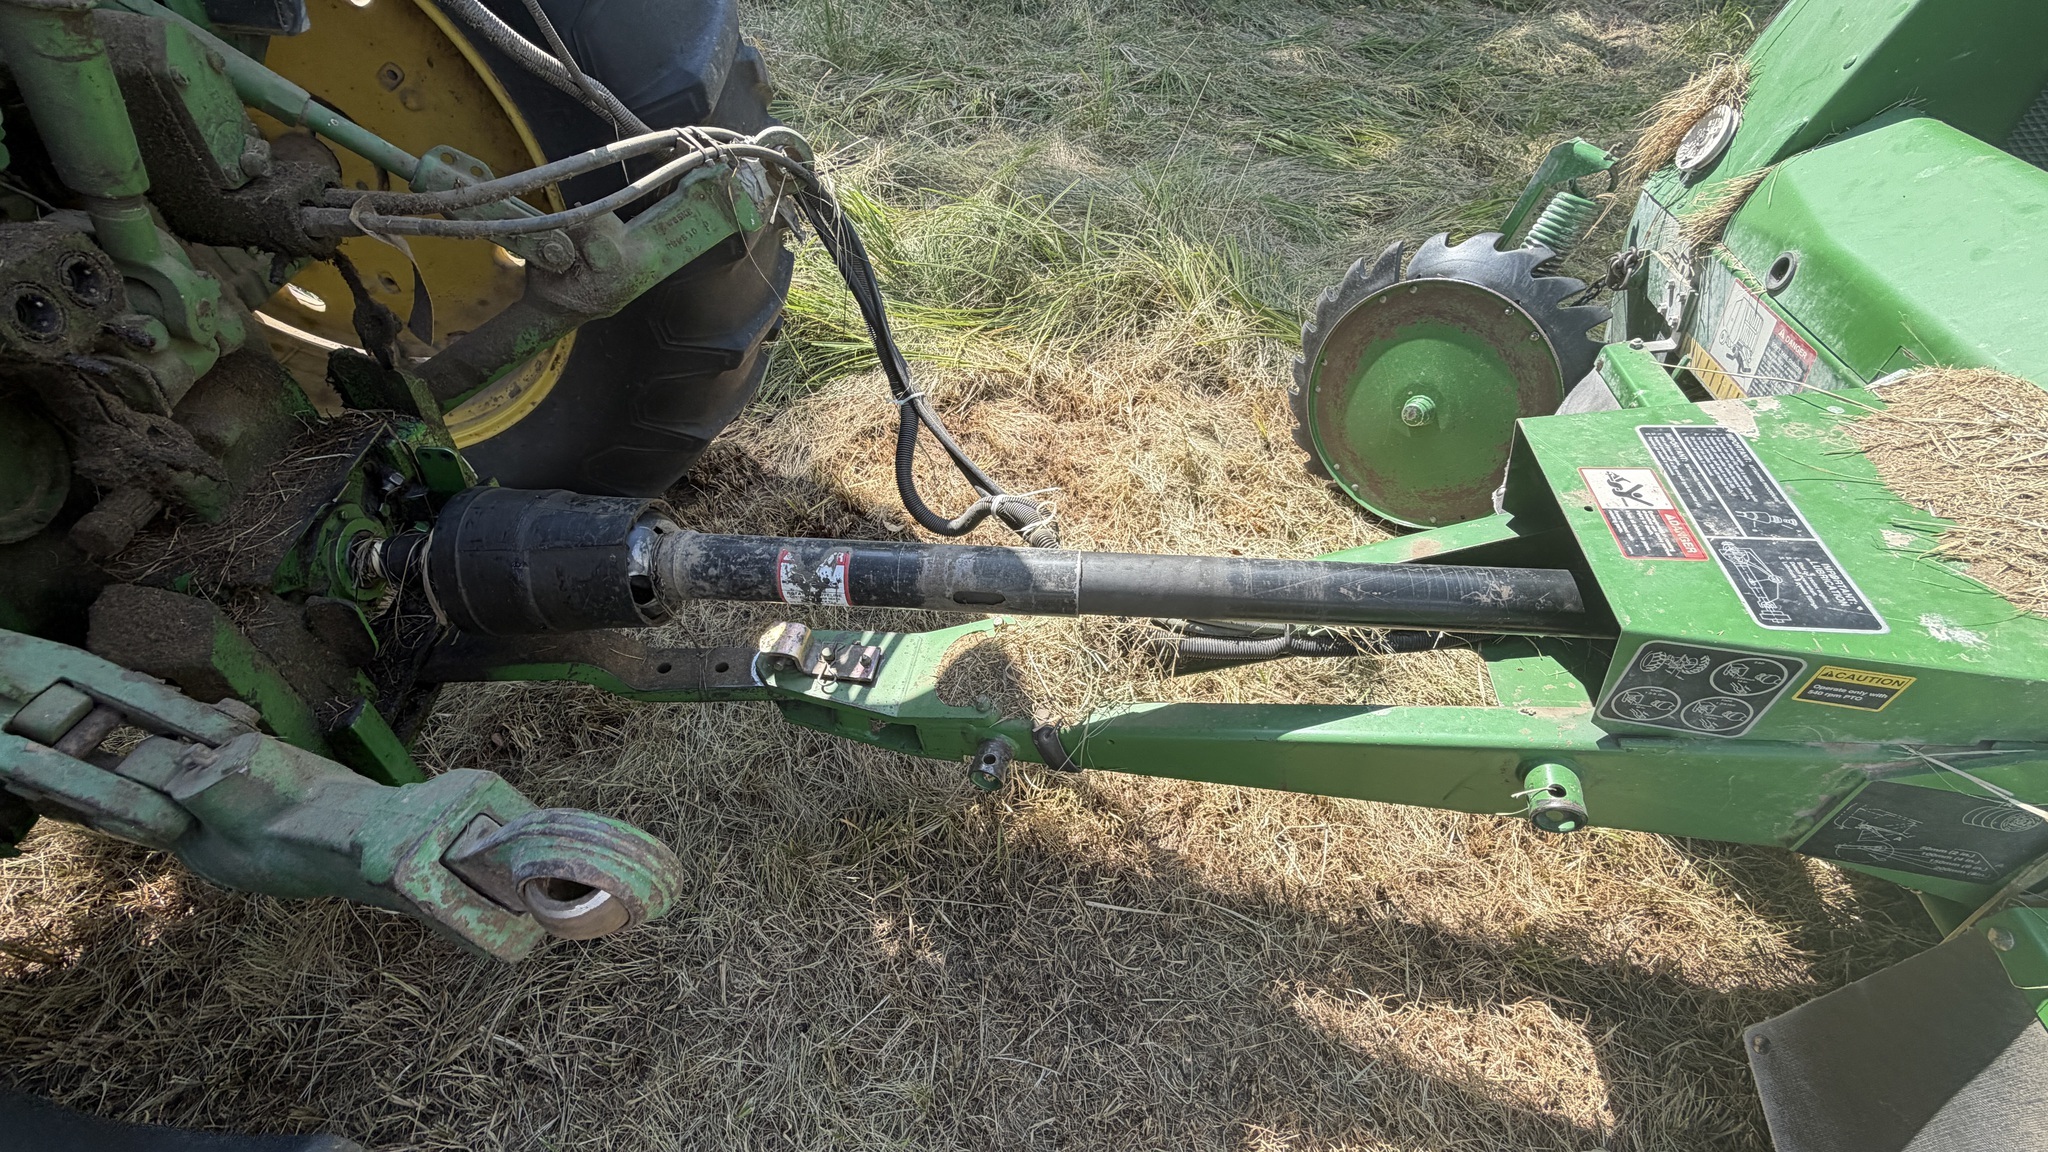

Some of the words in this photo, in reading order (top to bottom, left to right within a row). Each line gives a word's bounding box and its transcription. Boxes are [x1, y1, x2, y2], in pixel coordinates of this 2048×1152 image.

[1785, 336, 1806, 359] DANGER
[1668, 519, 1697, 553] DANGER
[1808, 561, 1850, 606] LUBRICATION
[1820, 563, 1859, 604] IMPORTANT:
[1813, 684, 1847, 693] Operate
[1848, 688, 1868, 697] only
[1869, 691, 1888, 699] with
[1835, 671, 1906, 687] CAUTION
